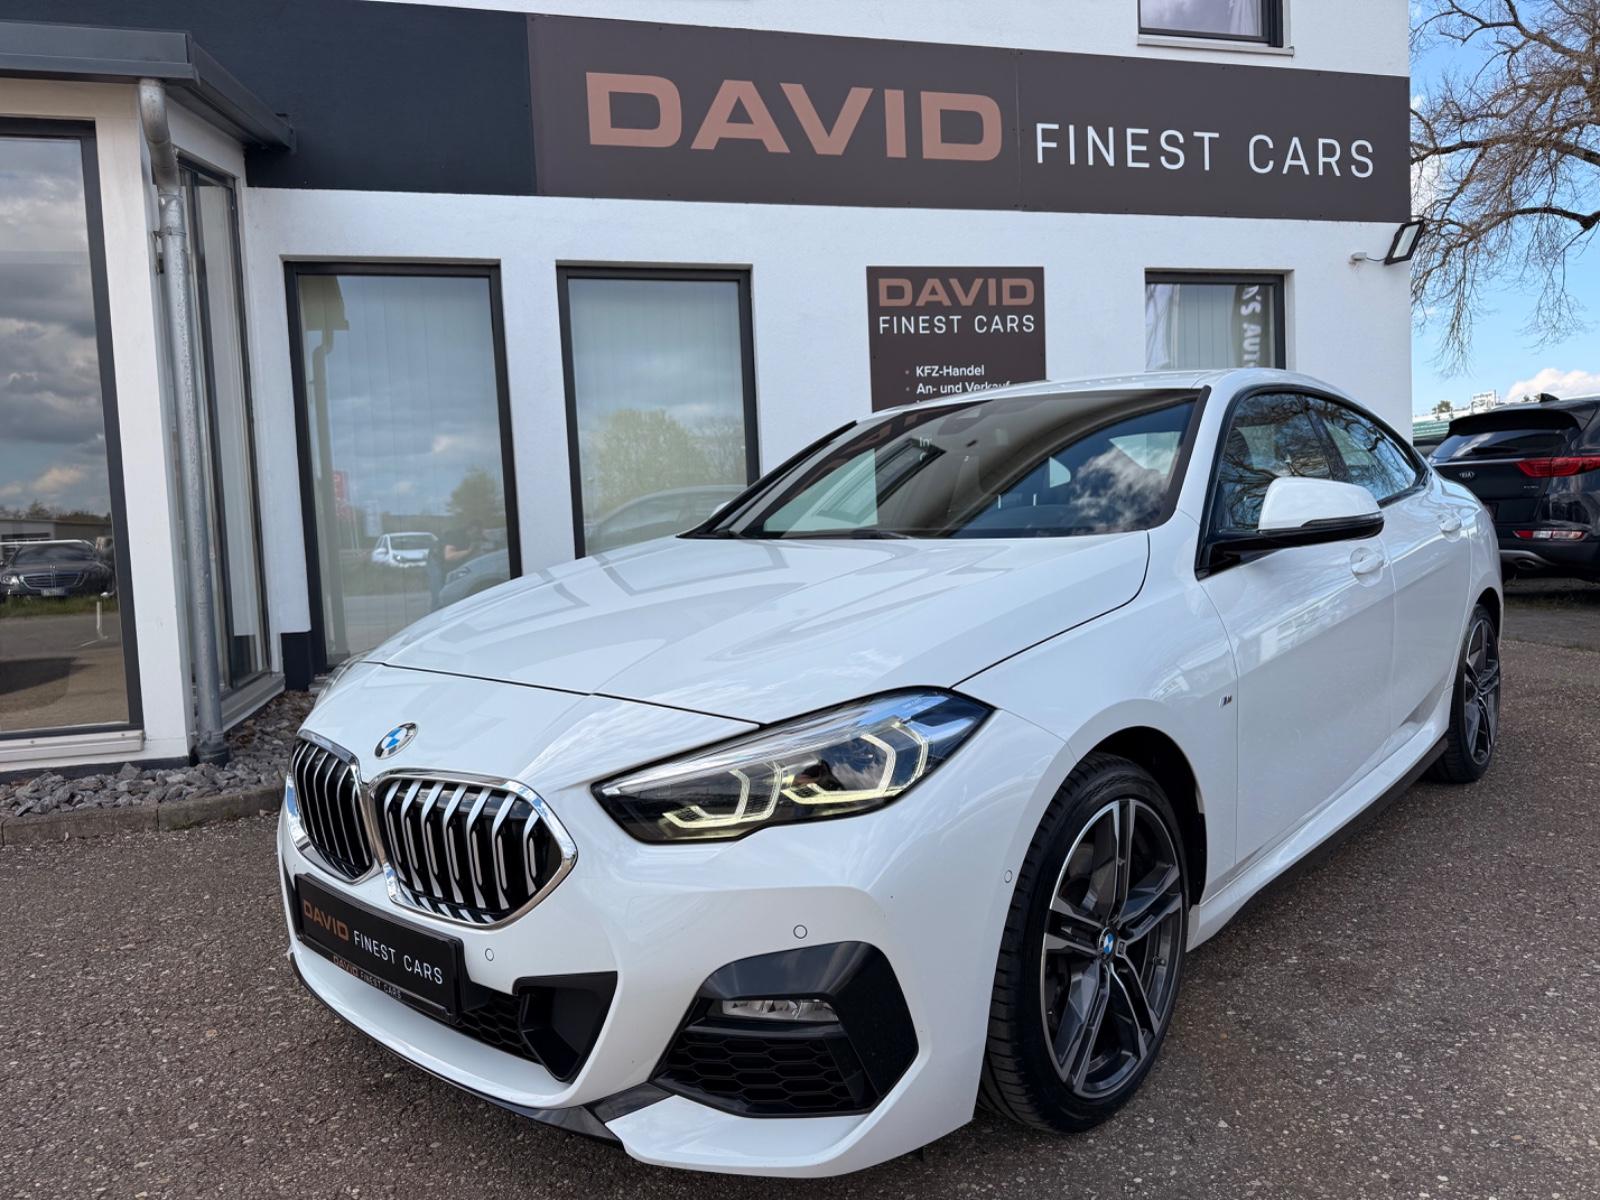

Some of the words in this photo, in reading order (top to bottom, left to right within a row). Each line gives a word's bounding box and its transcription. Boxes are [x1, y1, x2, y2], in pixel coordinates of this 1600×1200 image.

[586, 71, 1003, 162] DAVID
[1036, 122, 1220, 171] FINEST
[1248, 134, 1375, 179] CARS
[878, 278, 1035, 307] DAVID
[879, 315, 962, 334] FINEST
[974, 315, 1035, 333] CARS
[916, 364, 985, 377] KFZ-Handel
[916, 382, 937, 394] An-
[940, 382, 962, 394] und
[303, 899, 349, 942] DAVID
[353, 930, 396, 965] FINEST
[403, 954, 443, 985] CARS
[332, 955, 359, 977] DAVID
